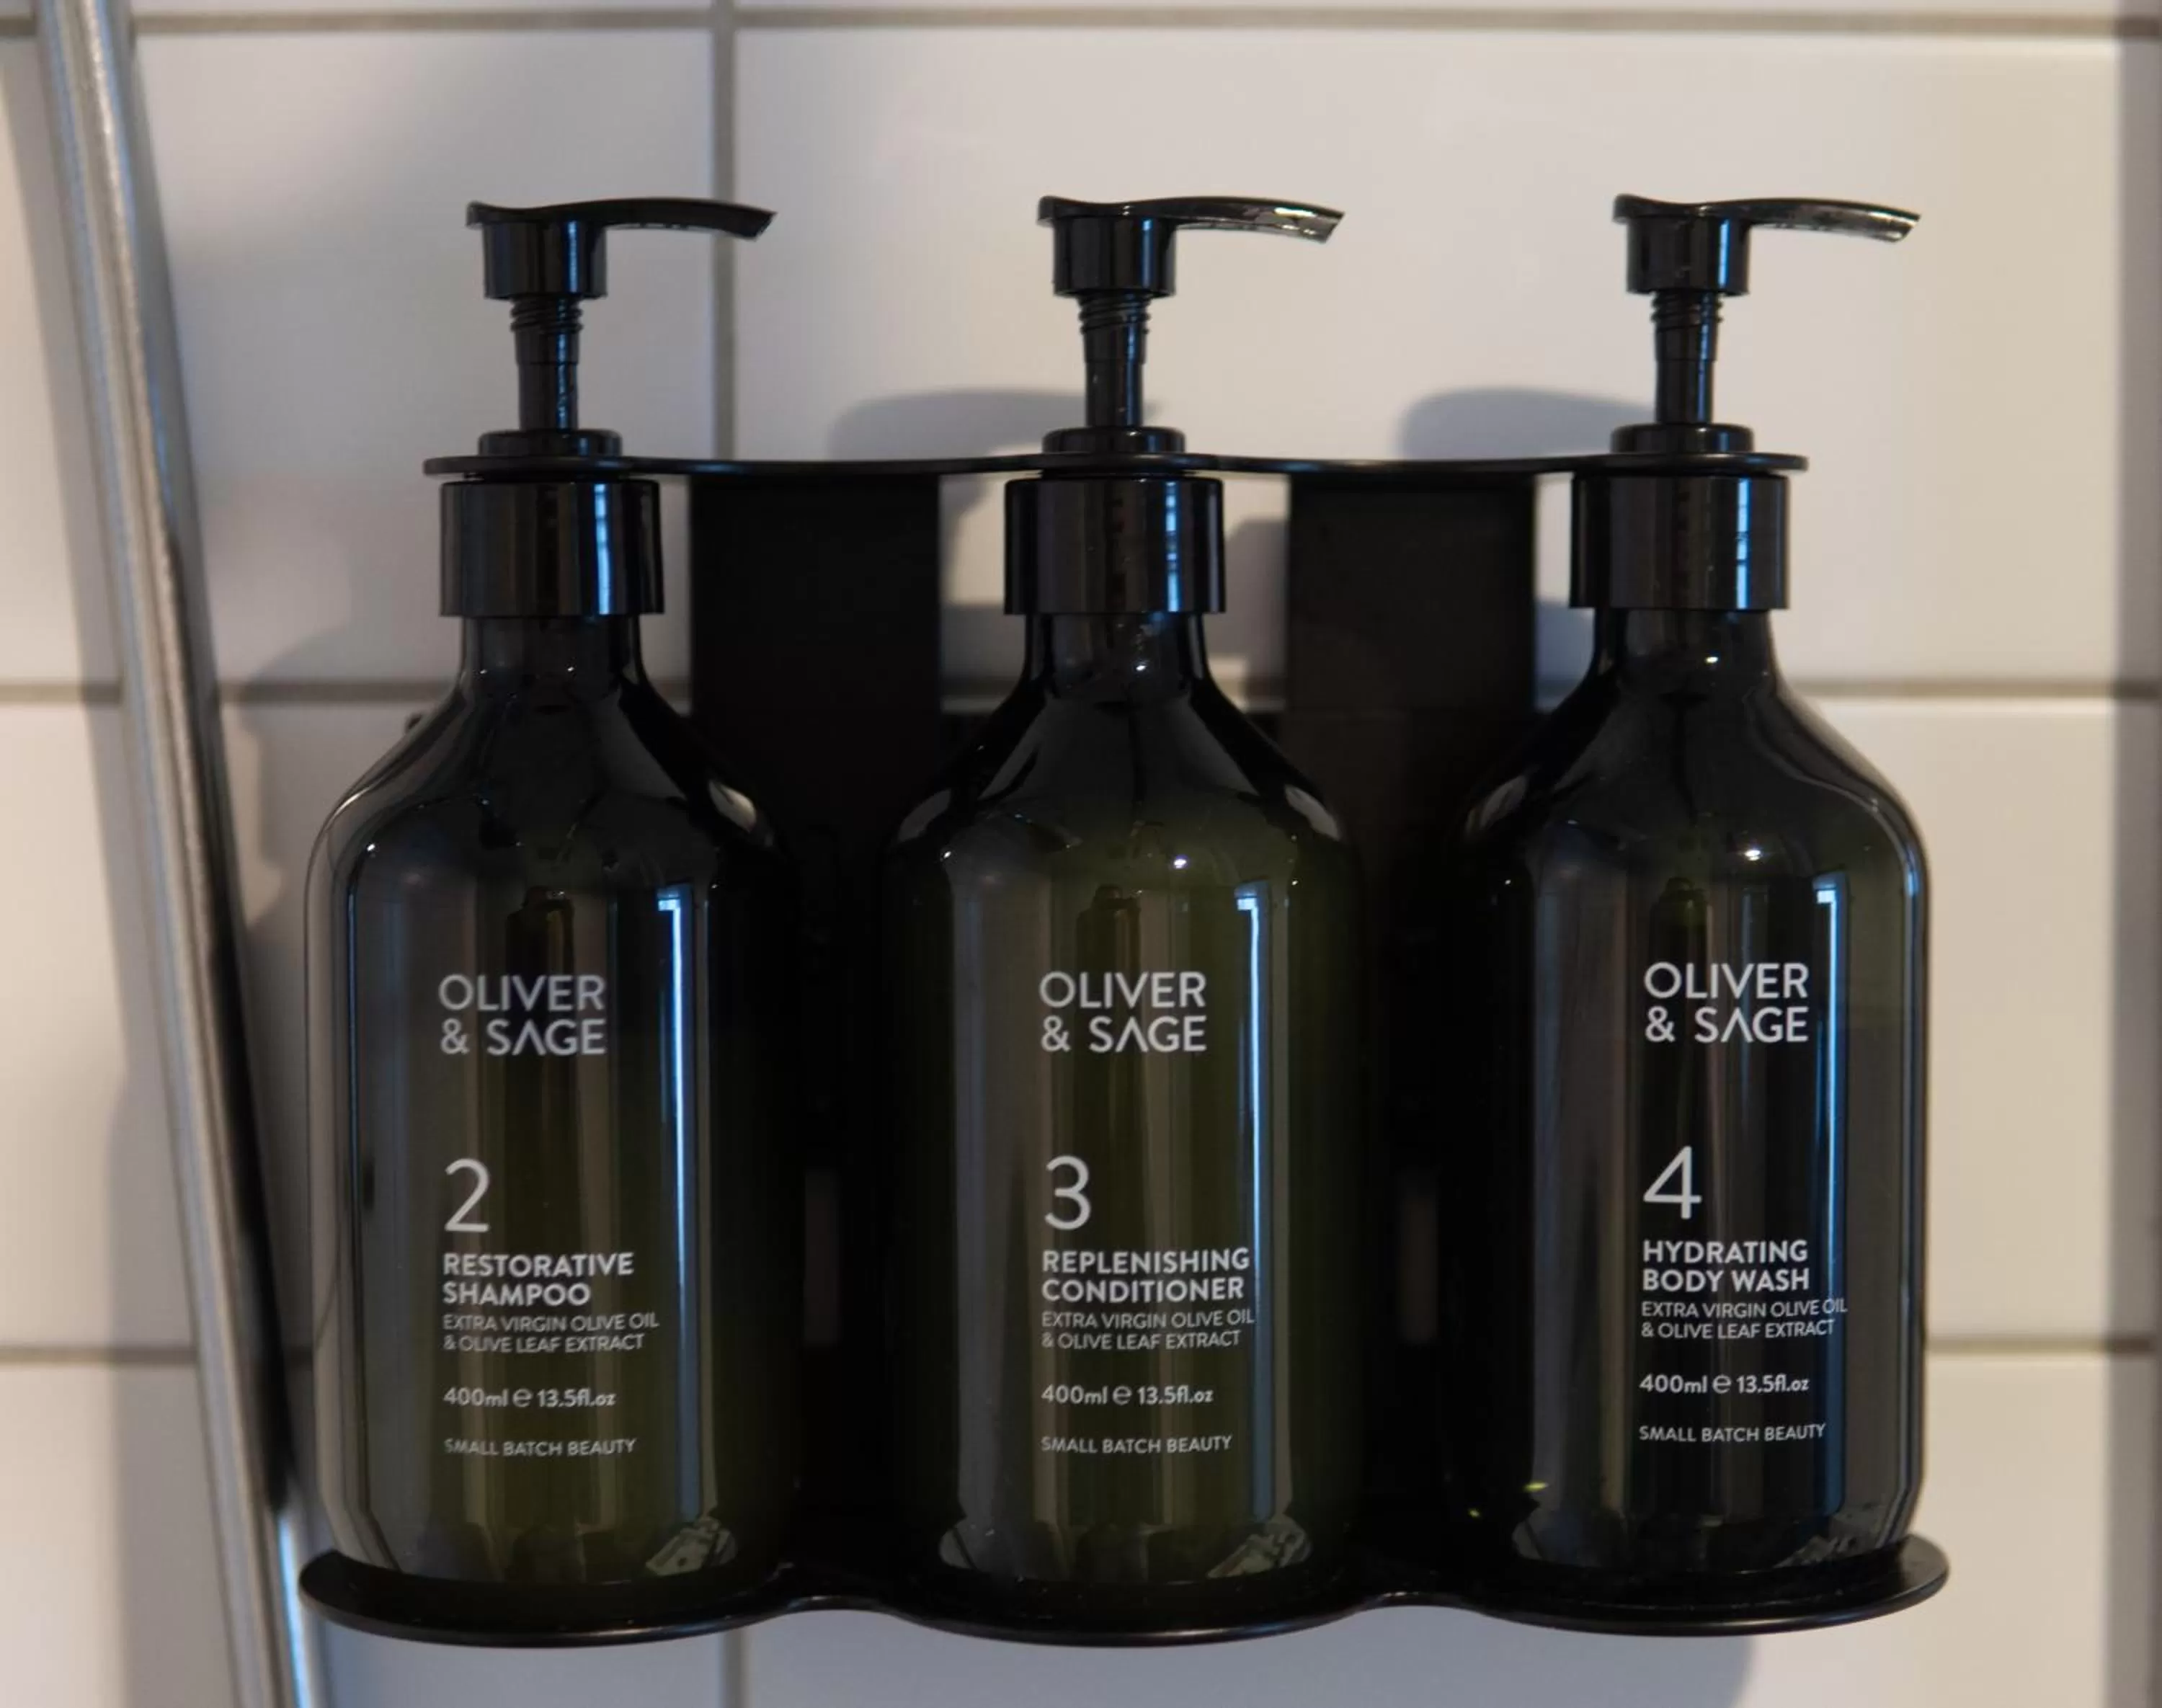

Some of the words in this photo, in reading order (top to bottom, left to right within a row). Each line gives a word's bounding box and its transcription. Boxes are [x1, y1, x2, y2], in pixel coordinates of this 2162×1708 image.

[1039, 971, 1206, 1008] OLIVER
[1644, 961, 1809, 998] OLIVER
[438, 974, 605, 1010] OLIVER
[1041, 1015, 1071, 1051] &
[1088, 1015, 1206, 1052] SAGE
[1645, 1005, 1675, 1042] &
[1694, 1005, 1809, 1042] SAGE
[440, 1018, 469, 1054] &
[486, 1018, 606, 1054] SAGE
[1044, 1155, 1091, 1230] 3
[1642, 1144, 1702, 1219] 4
[444, 1157, 490, 1232] 2
[1042, 1247, 1250, 1273] REPLENISHING
[1643, 1239, 1808, 1263] HYDRATING
[443, 1252, 634, 1277] RESTORATIVE
[1042, 1276, 1245, 1302] CONDITIONER
[1643, 1268, 1723, 1291] BODY
[1731, 1268, 1810, 1291] WASH
[442, 1281, 590, 1305] SHAMPOO
[1042, 1310, 1098, 1327] EXTRA
[1101, 1312, 1167, 1328] VIRGIN
[1170, 1309, 1224, 1327] OLIVE
[1227, 1308, 1255, 1325] OIL
[1642, 1300, 1699, 1317] EXTRA
[1702, 1302, 1767, 1317] VIRGIN
[1770, 1299, 1820, 1316] OLIVE
[1823, 1297, 1847, 1314] OIL
[443, 1314, 497, 1330] EXTRA
[501, 1315, 566, 1332] VIRGIN
[570, 1314, 626, 1330] OLIVE
[629, 1312, 659, 1329] OIL
[1642, 1321, 1654, 1337] &
[1658, 1321, 1713, 1338] OLIVE
[1717, 1321, 1761, 1338] LEAF
[1765, 1318, 1836, 1337] EXTRACT
[443, 1334, 455, 1349] &
[458, 1335, 512, 1352] OLIVE
[516, 1335, 561, 1352] LEAF
[564, 1333, 644, 1352] EXTRACT
[1041, 1330, 1054, 1348] &
[1057, 1331, 1113, 1348] OLIVE
[1116, 1332, 1161, 1349] LEAF
[1166, 1329, 1241, 1348] EXTRACT
[1041, 1435, 1097, 1453] SMALL
[1102, 1437, 1161, 1453] BATCH
[1166, 1434, 1232, 1452] BEAUTY
[1640, 1425, 1696, 1441] SMALL
[1701, 1426, 1759, 1441] BATCH
[1764, 1422, 1826, 1441] BEAUTY
[443, 1438, 499, 1455] SMALL
[503, 1440, 562, 1456] BATCH
[568, 1437, 637, 1455] BEAUTY
